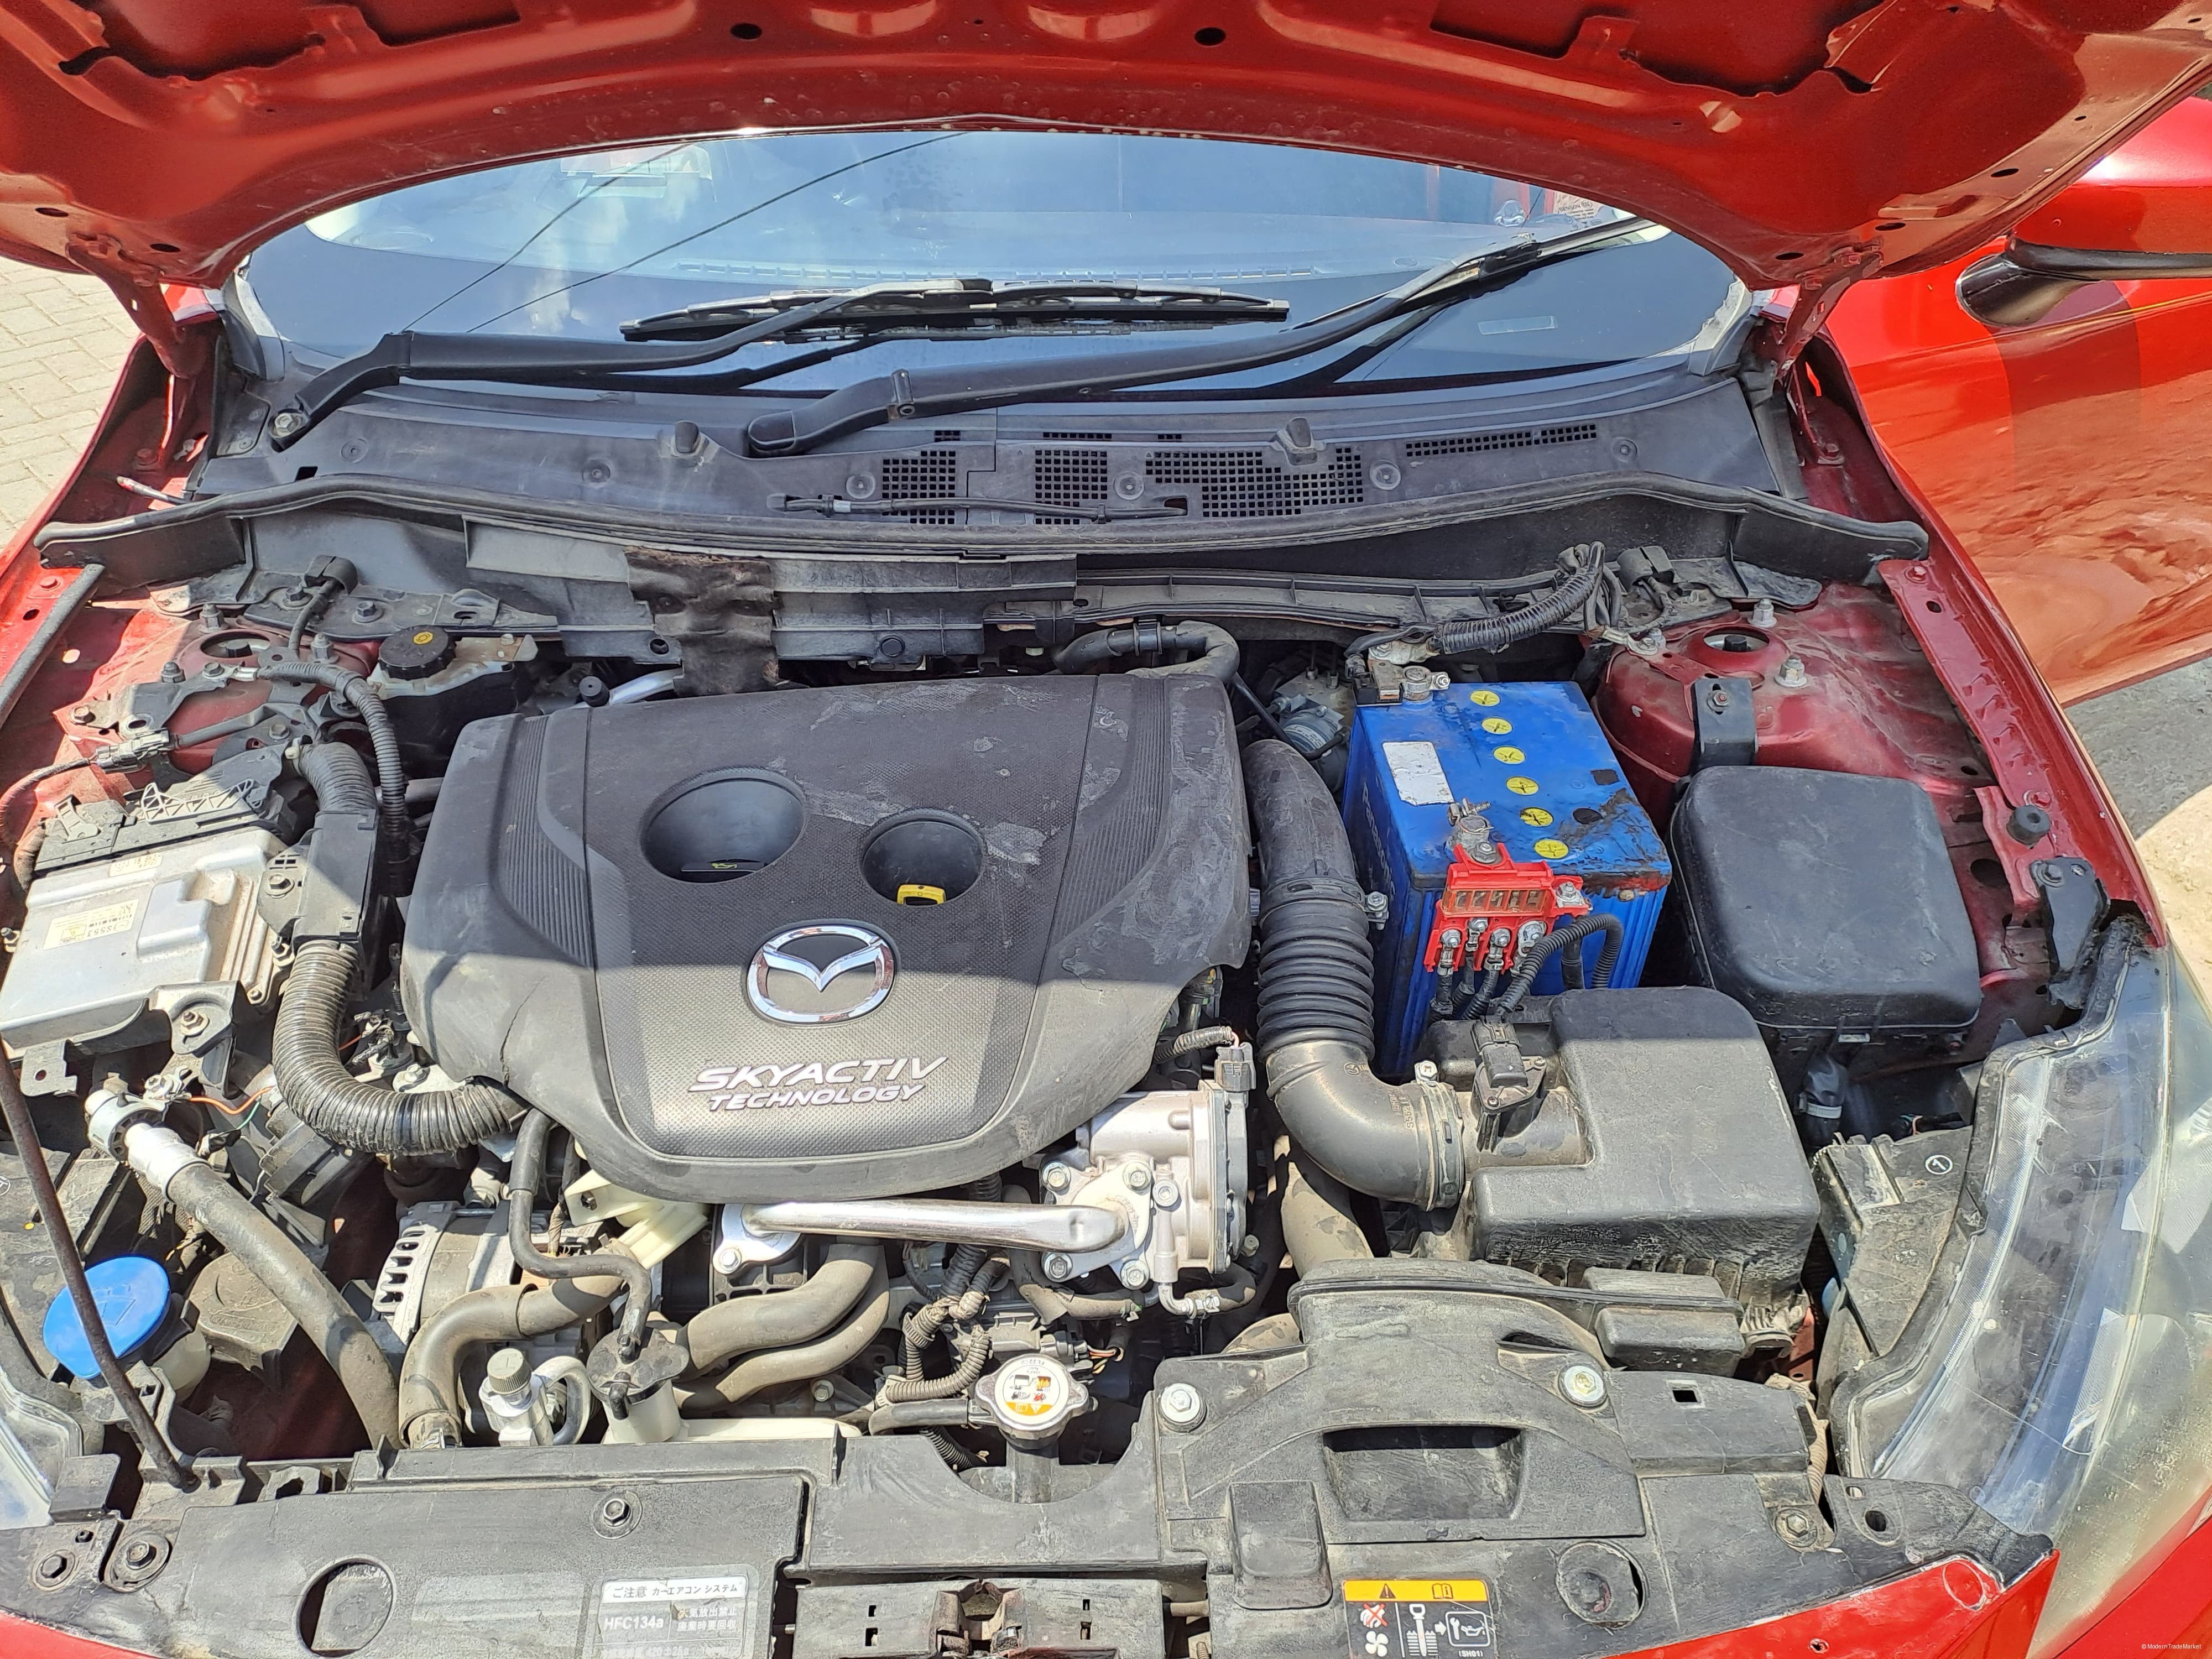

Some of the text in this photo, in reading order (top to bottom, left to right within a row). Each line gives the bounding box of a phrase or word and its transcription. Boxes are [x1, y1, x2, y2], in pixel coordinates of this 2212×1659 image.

[688, 1057, 948, 1092] SKYACTIV
[709, 1084, 926, 1111] TECHNOLOGY
[613, 1587, 648, 1598] ご注意
[705, 1584, 738, 1594] システム
[604, 1615, 665, 1630] HFC134a
